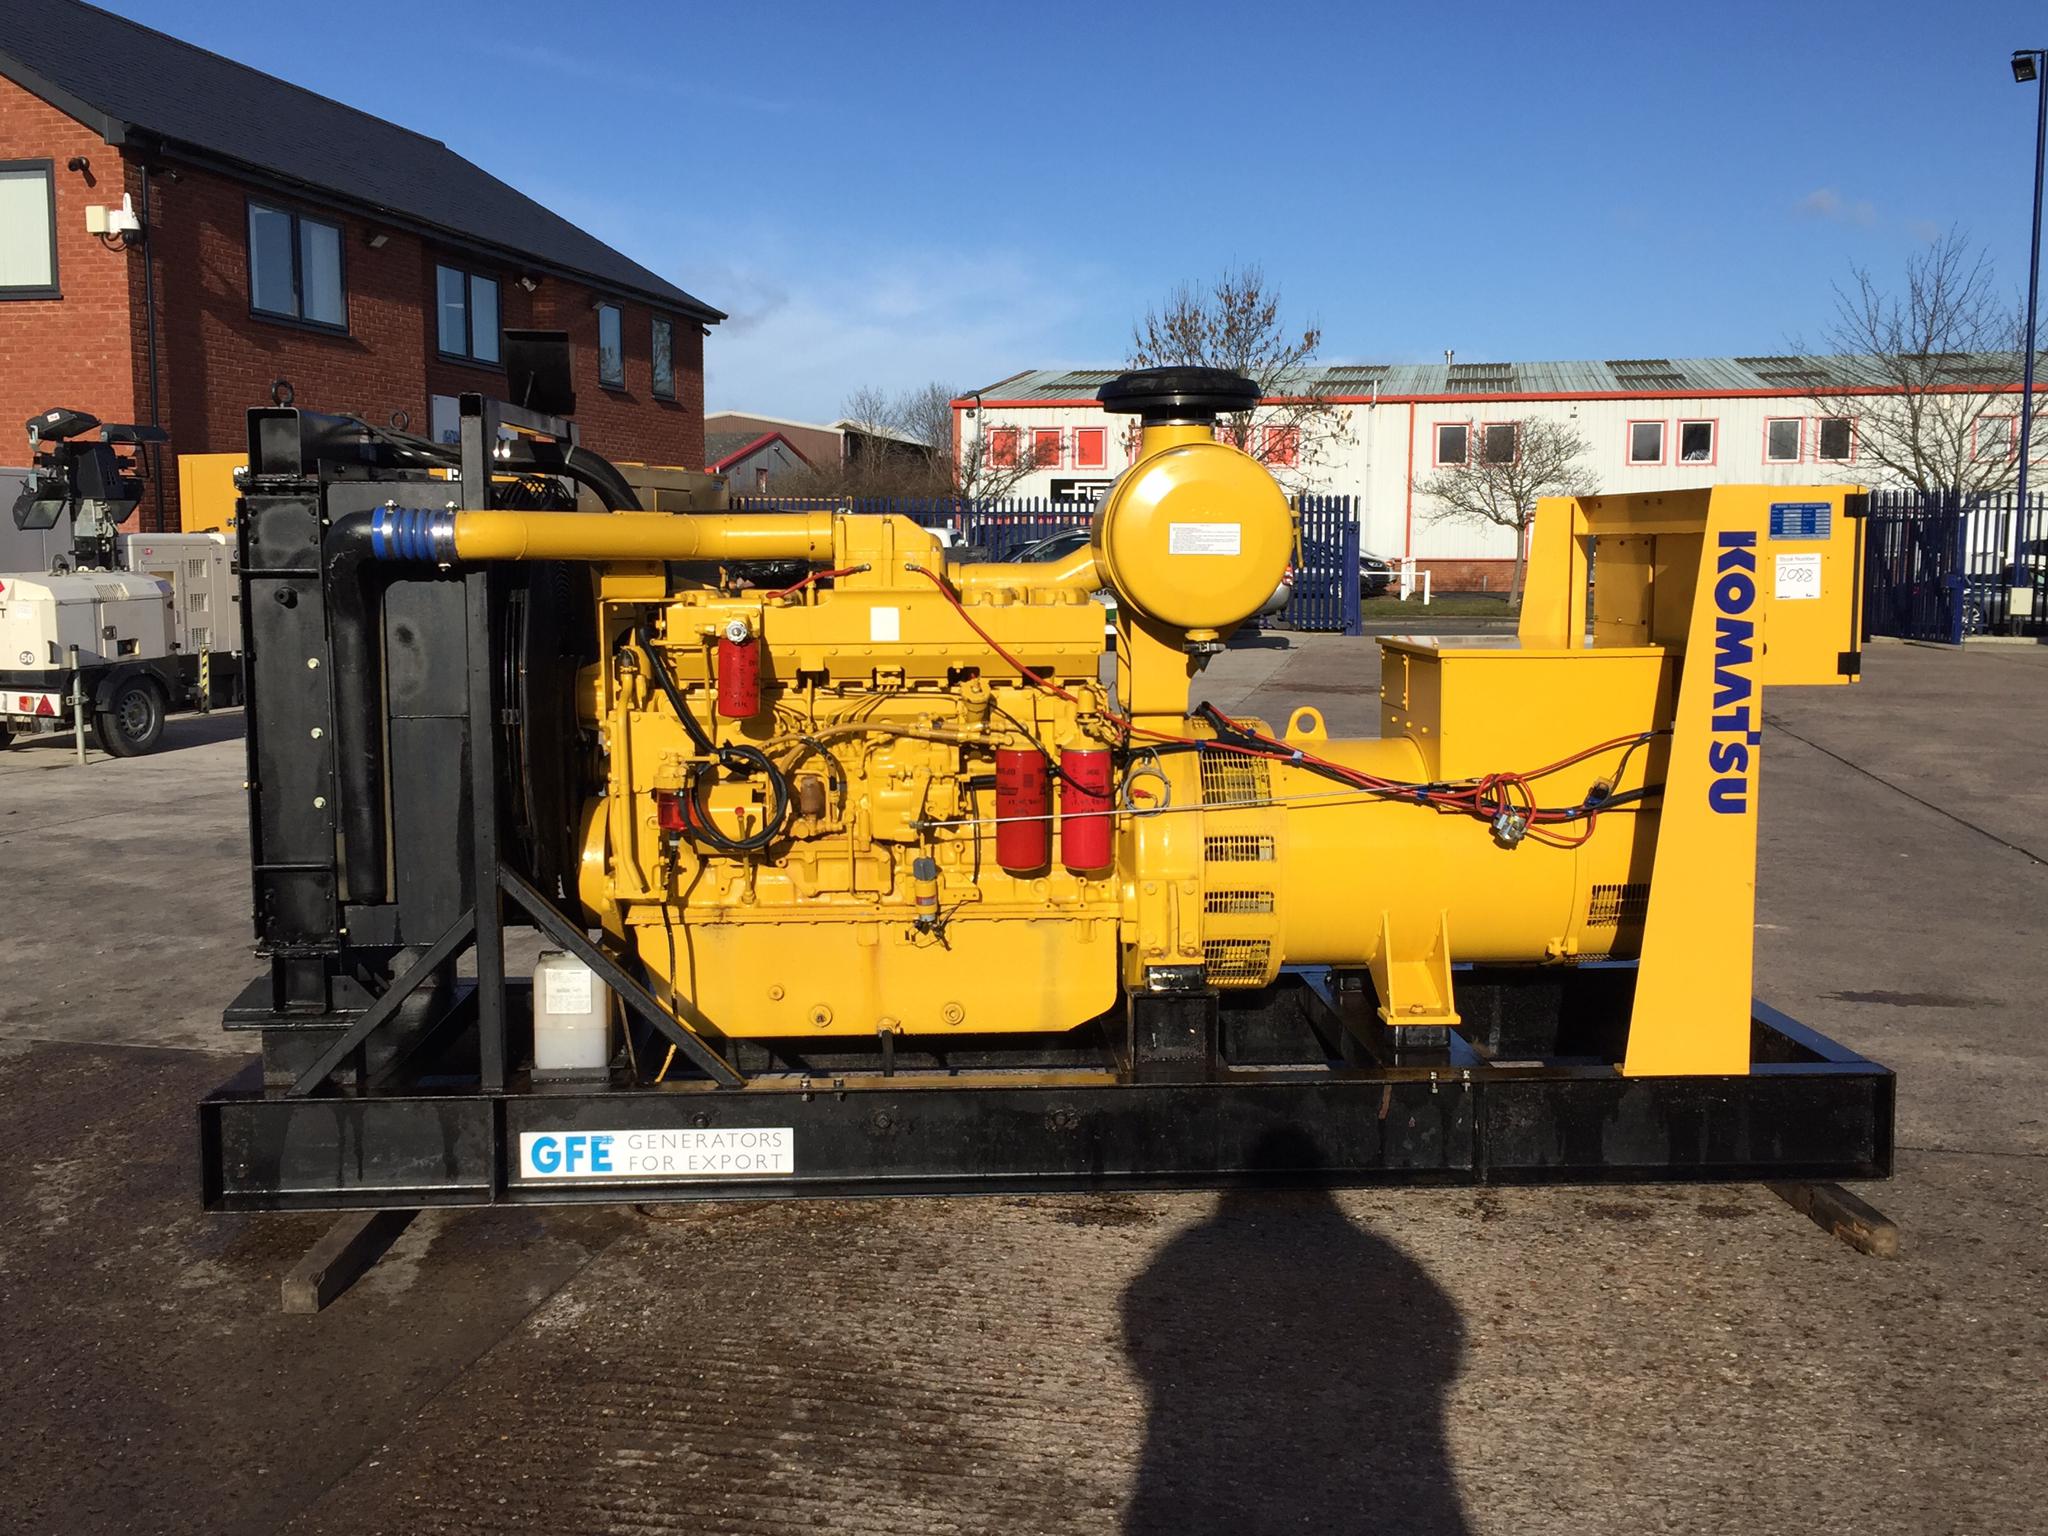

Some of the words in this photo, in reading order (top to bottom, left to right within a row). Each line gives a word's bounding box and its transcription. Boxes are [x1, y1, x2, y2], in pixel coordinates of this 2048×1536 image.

[1778, 566, 1813, 583] 2088
[1708, 530, 1761, 815] KOMATSU
[531, 1136, 614, 1173] GFE
[628, 1132, 783, 1151] GENERATORS
[629, 1155, 675, 1172] FOR
[688, 1153, 783, 1171] EXPORT
